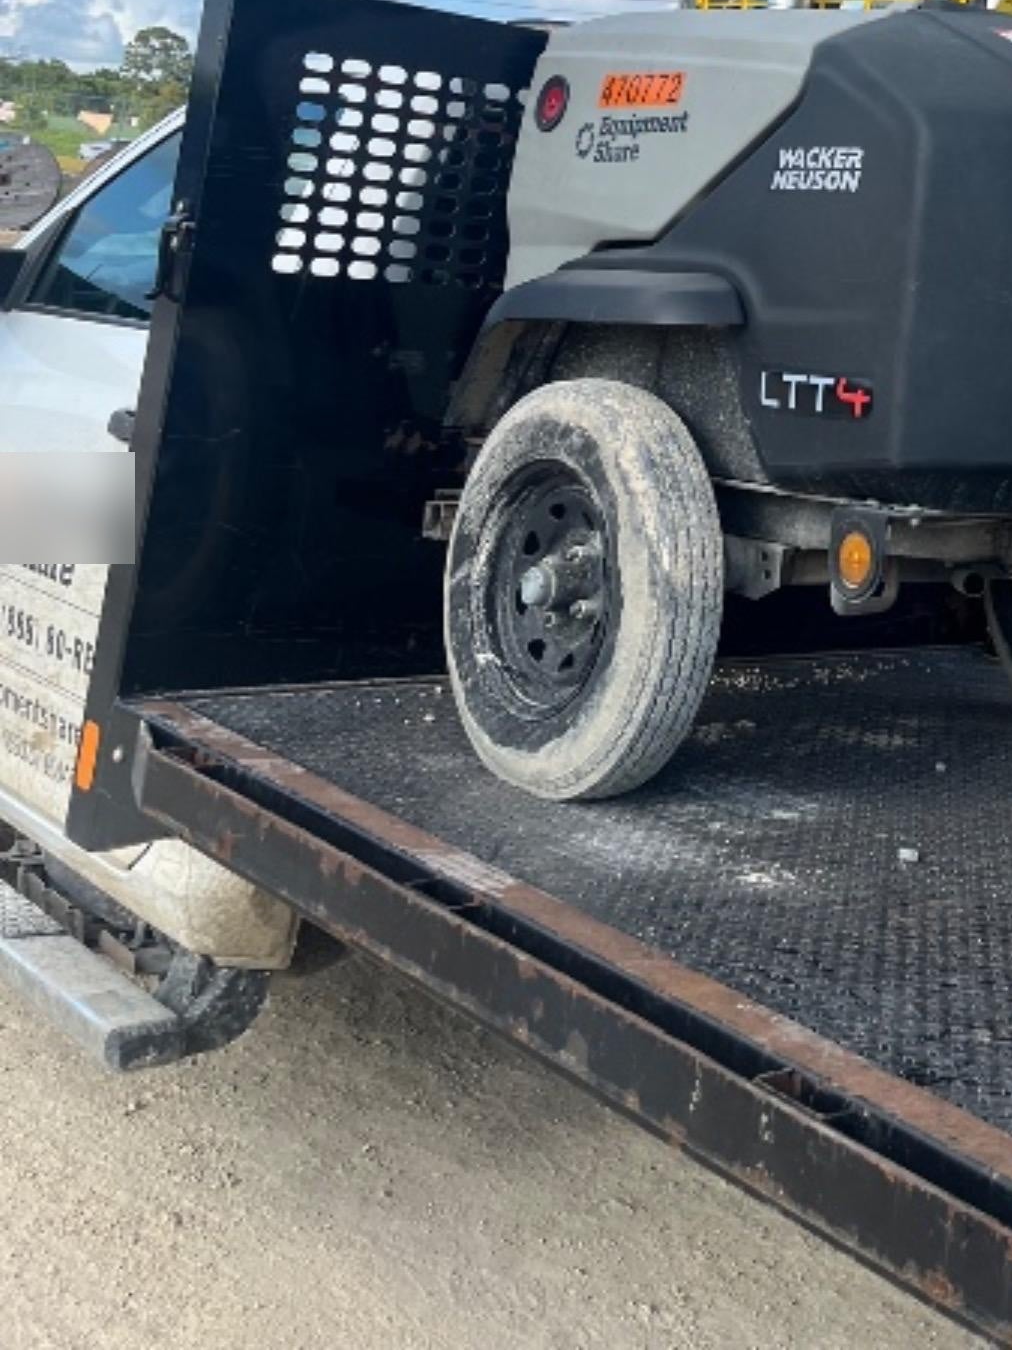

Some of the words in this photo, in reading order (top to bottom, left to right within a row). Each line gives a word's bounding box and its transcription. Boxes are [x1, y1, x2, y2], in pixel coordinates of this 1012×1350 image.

[601, 73, 683, 105] 470772
[599, 111, 688, 141] Equipment
[593, 141, 640, 163] Share
[778, 147, 864, 169] WACKER
[769, 170, 862, 194] NEUSON
[759, 370, 872, 418] LTT4
